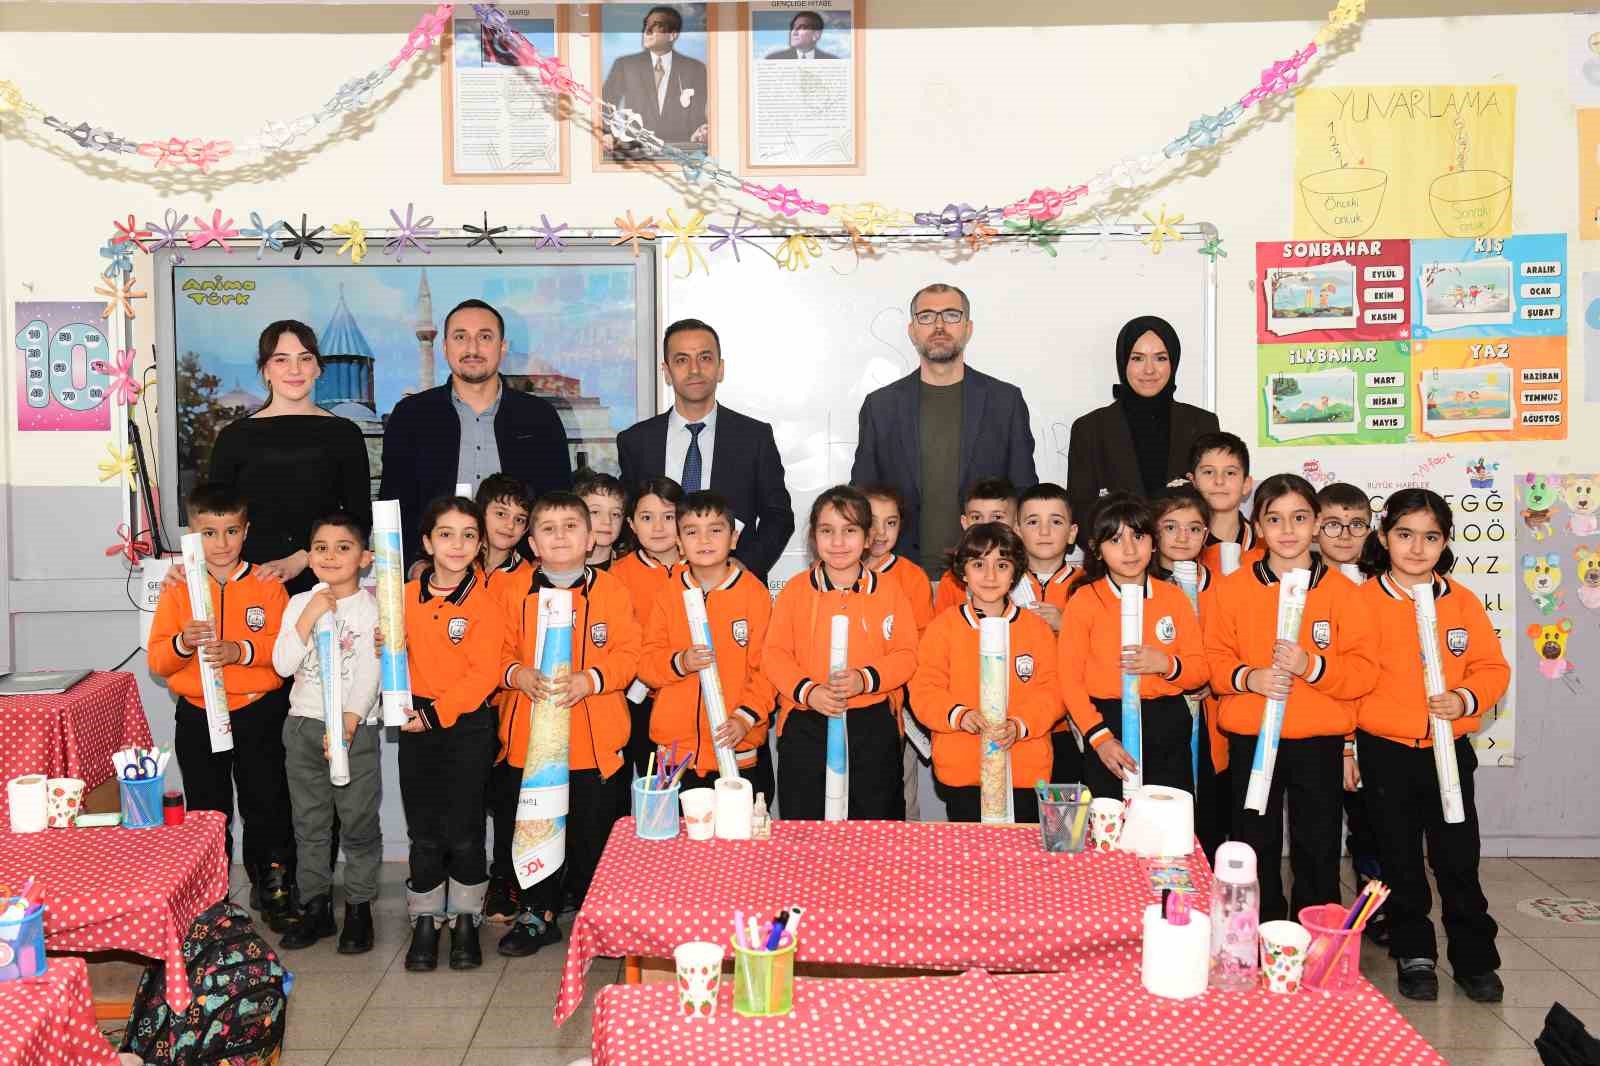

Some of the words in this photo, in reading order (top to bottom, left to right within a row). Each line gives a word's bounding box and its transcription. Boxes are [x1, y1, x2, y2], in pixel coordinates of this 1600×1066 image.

[1331, 87, 1501, 122] YUVARLAMA
[1282, 240, 1382, 258] SONBAHAR
[1473, 236, 1505, 254] KIŞ
[1371, 269, 1396, 279] EYLÜL
[1525, 264, 1556, 275] ARALIK
[1373, 289, 1394, 301] EKİM
[1529, 286, 1552, 296] OCAK
[1371, 311, 1398, 321] KASIM
[1527, 308, 1555, 319] ŞUBAT
[1288, 347, 1378, 365] İLKBAHAR
[1470, 343, 1511, 360] YAZ
[1373, 375, 1396, 385] MART
[1522, 370, 1560, 382] HAZİRAN
[1372, 395, 1398, 406] NİSAN
[1524, 392, 1559, 403] TEMMUZ
[1372, 417, 1398, 428] MAYIS
[1522, 412, 1561, 424] AĞUSTOS
[1367, 479, 1393, 489] BÜYÜK
[1461, 494, 1479, 512] G
[1485, 489, 1504, 512] Ğ
[1463, 524, 1481, 542] O
[1486, 518, 1505, 542] Ö
[1466, 556, 1480, 574] Y
[1486, 556, 1499, 574] Z
